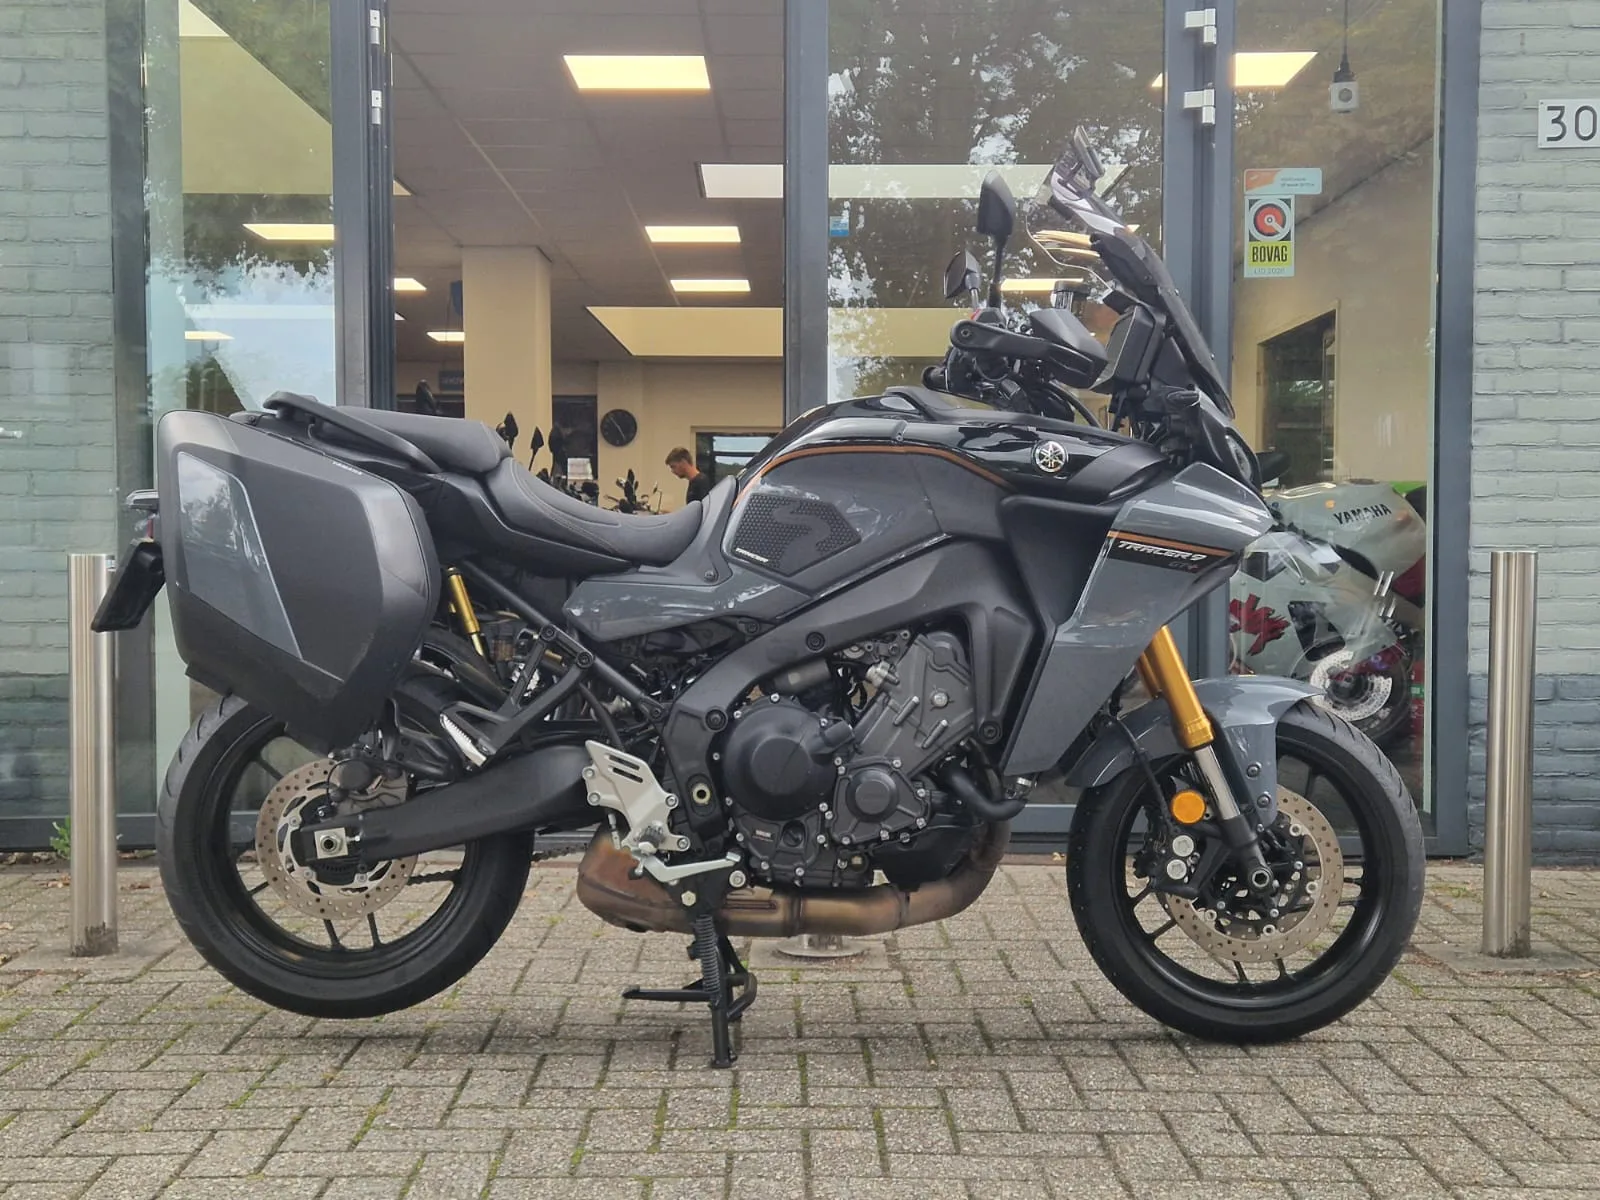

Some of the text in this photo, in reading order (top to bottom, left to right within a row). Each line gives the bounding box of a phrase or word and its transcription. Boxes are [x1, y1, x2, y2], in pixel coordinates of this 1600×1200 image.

[1546, 105, 1598, 142] 30
[1252, 245, 1288, 263] BOVAG
[1333, 503, 1393, 524] YAMAHA
